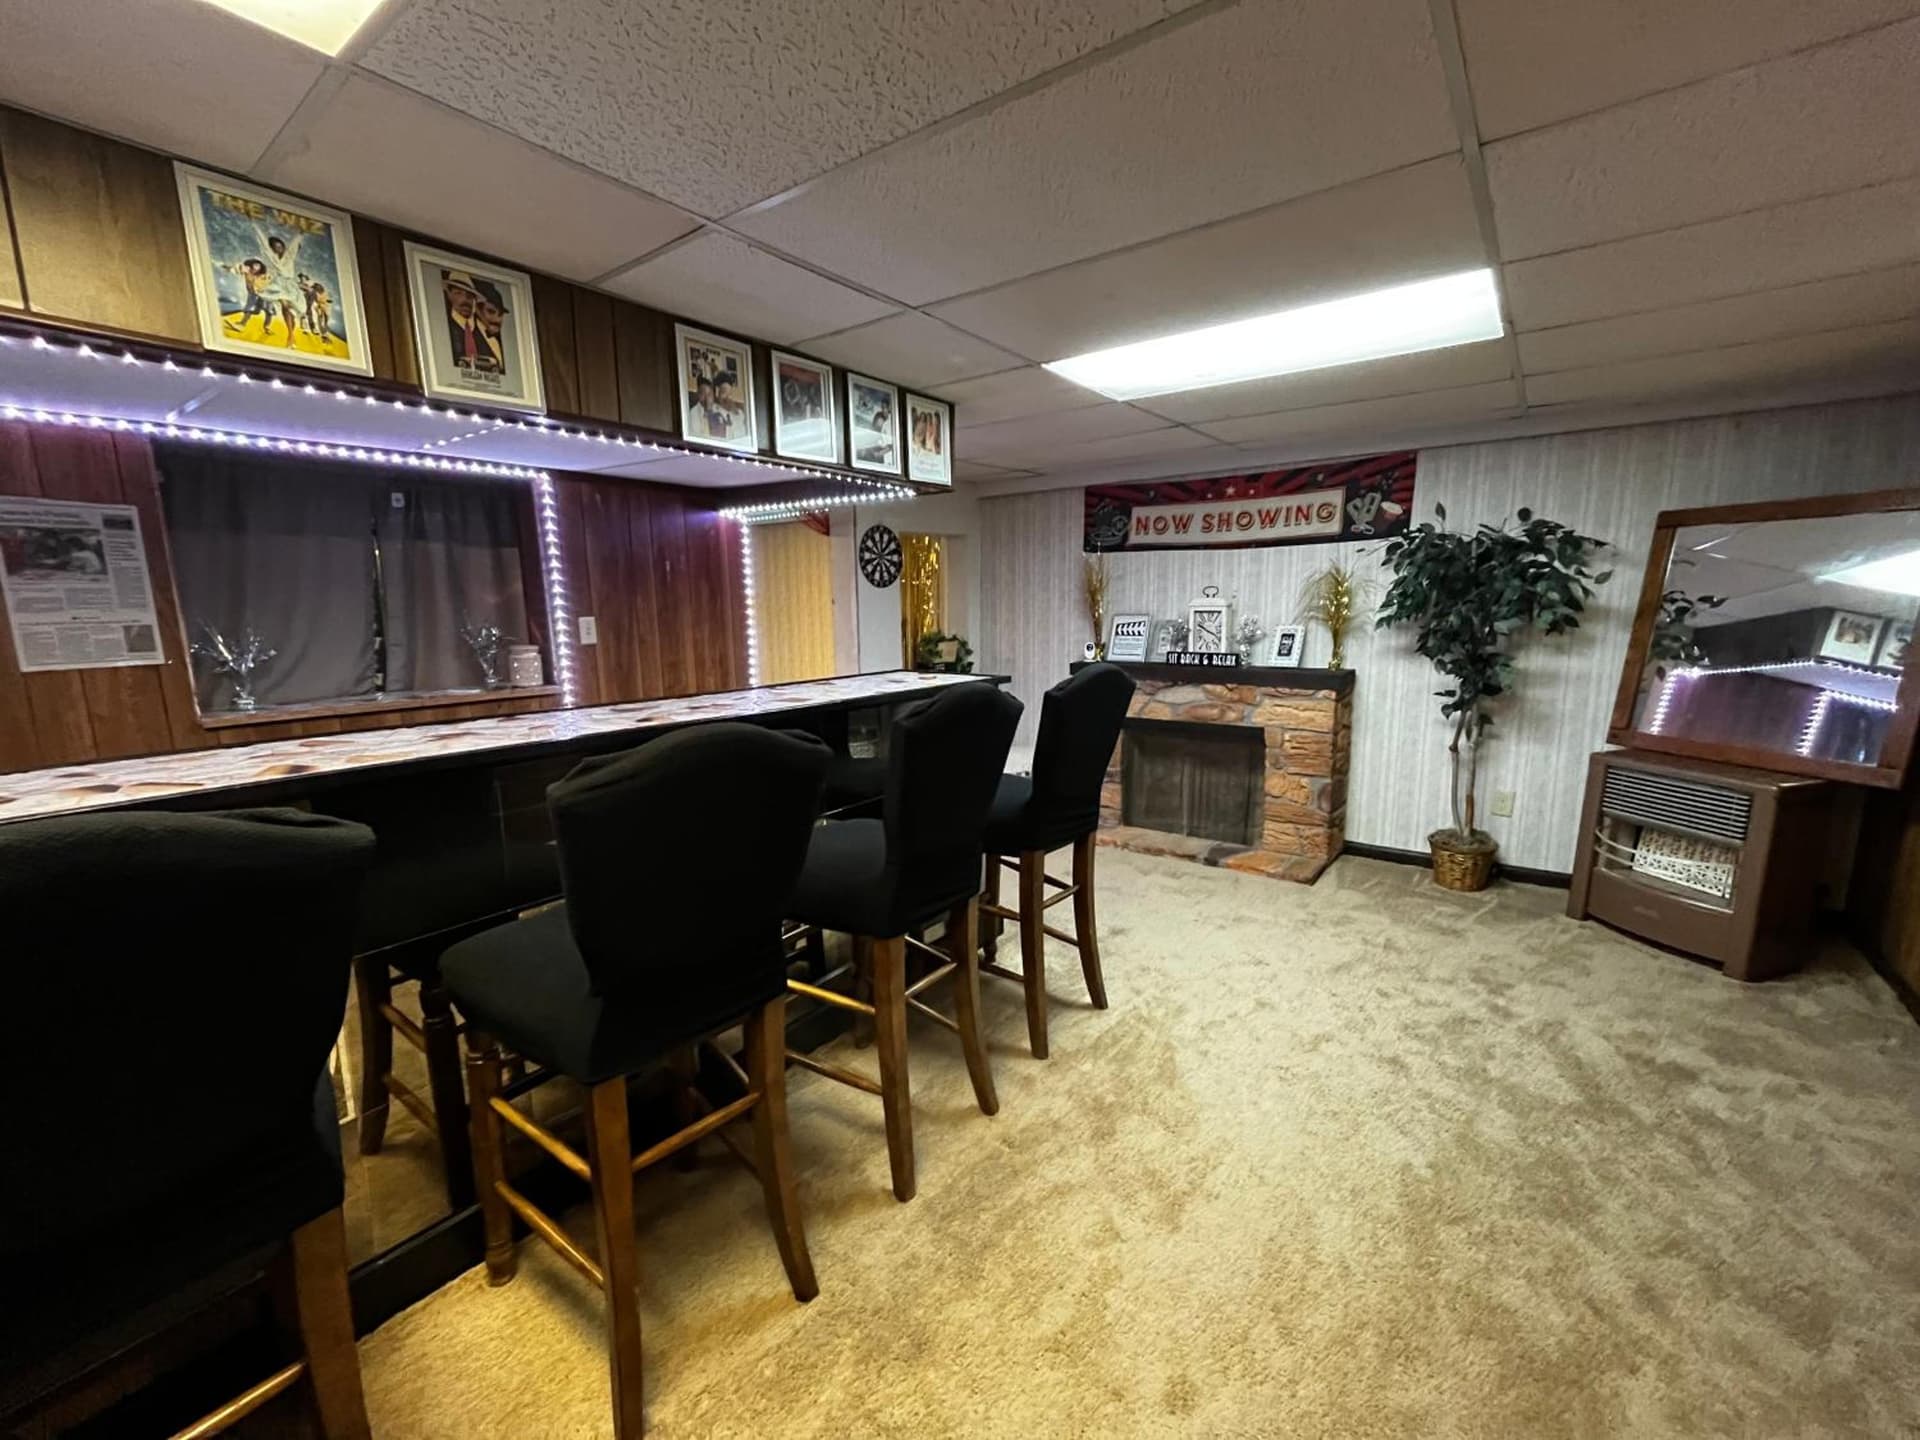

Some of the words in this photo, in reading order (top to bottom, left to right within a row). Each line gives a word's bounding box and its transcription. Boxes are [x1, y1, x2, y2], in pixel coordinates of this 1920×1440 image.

[209, 190, 266, 220] THE
[1135, 514, 1194, 535] NOW
[1201, 503, 1337, 533] SHOWING
[1168, 652, 1178, 665] SIT
[1180, 653, 1200, 665] BACK
[1212, 654, 1237, 667] RELAX
